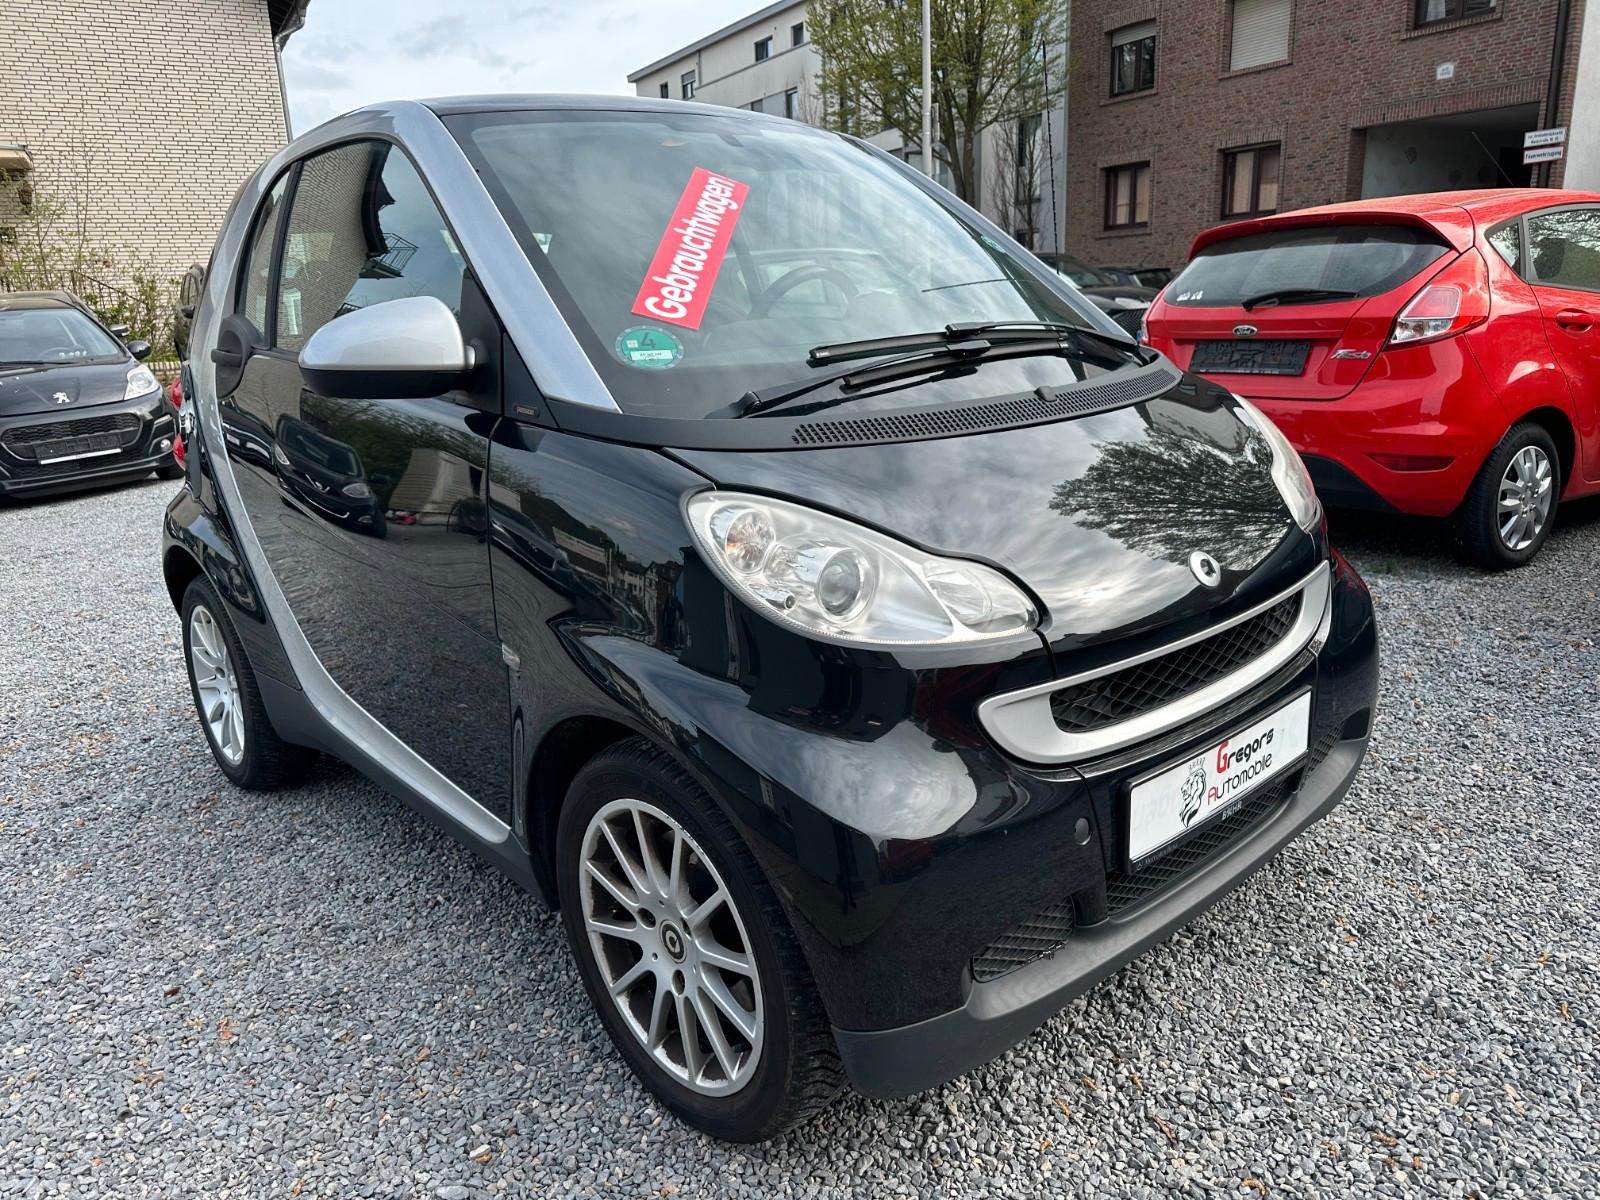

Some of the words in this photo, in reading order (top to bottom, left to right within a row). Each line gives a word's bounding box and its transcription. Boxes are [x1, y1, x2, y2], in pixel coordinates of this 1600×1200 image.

[644, 176, 738, 319] Gebrauchtwagen
[641, 332, 657, 348] 4
[1217, 728, 1274, 774] Gregors
